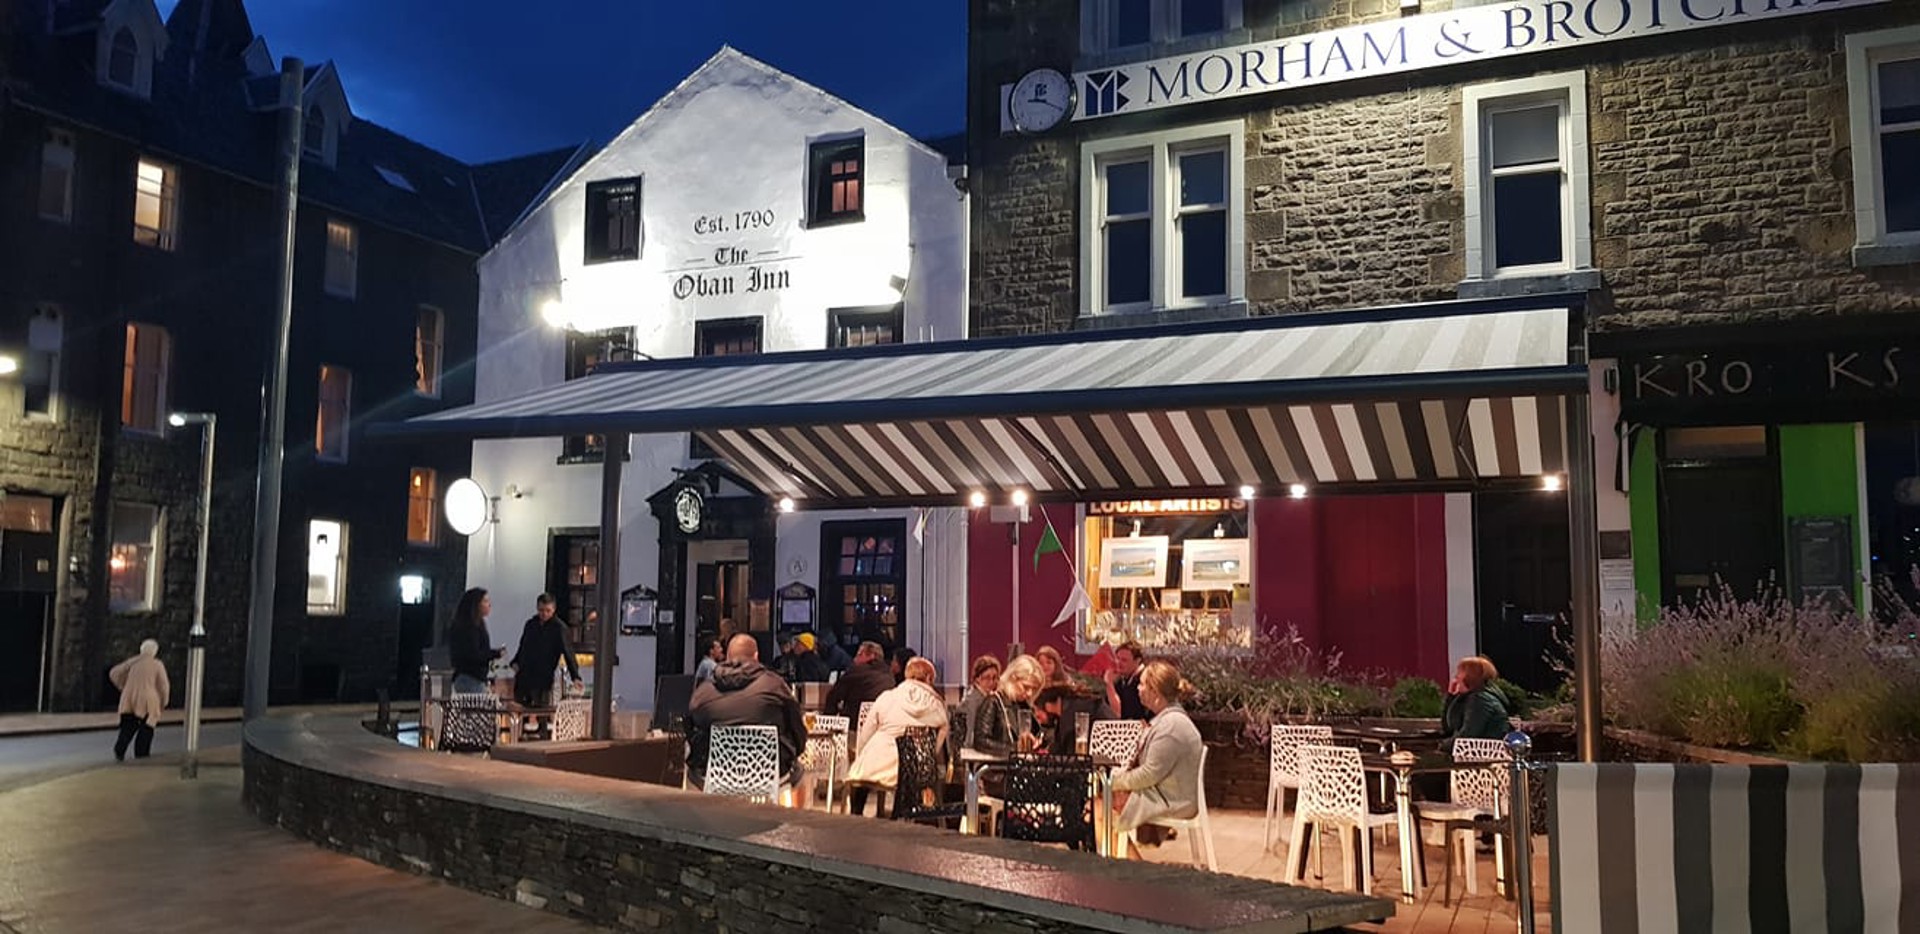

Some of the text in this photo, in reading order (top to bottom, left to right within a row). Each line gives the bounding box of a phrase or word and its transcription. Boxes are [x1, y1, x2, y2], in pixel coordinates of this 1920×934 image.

[1145, 26, 1408, 104] MORHAM
[1434, 18, 1484, 59] &
[694, 209, 775, 235] Est. 1790
[714, 247, 748, 265] The
[673, 266, 790, 300] Oban Inn
[1090, 498, 1246, 514] LOCAL ARTISTS
